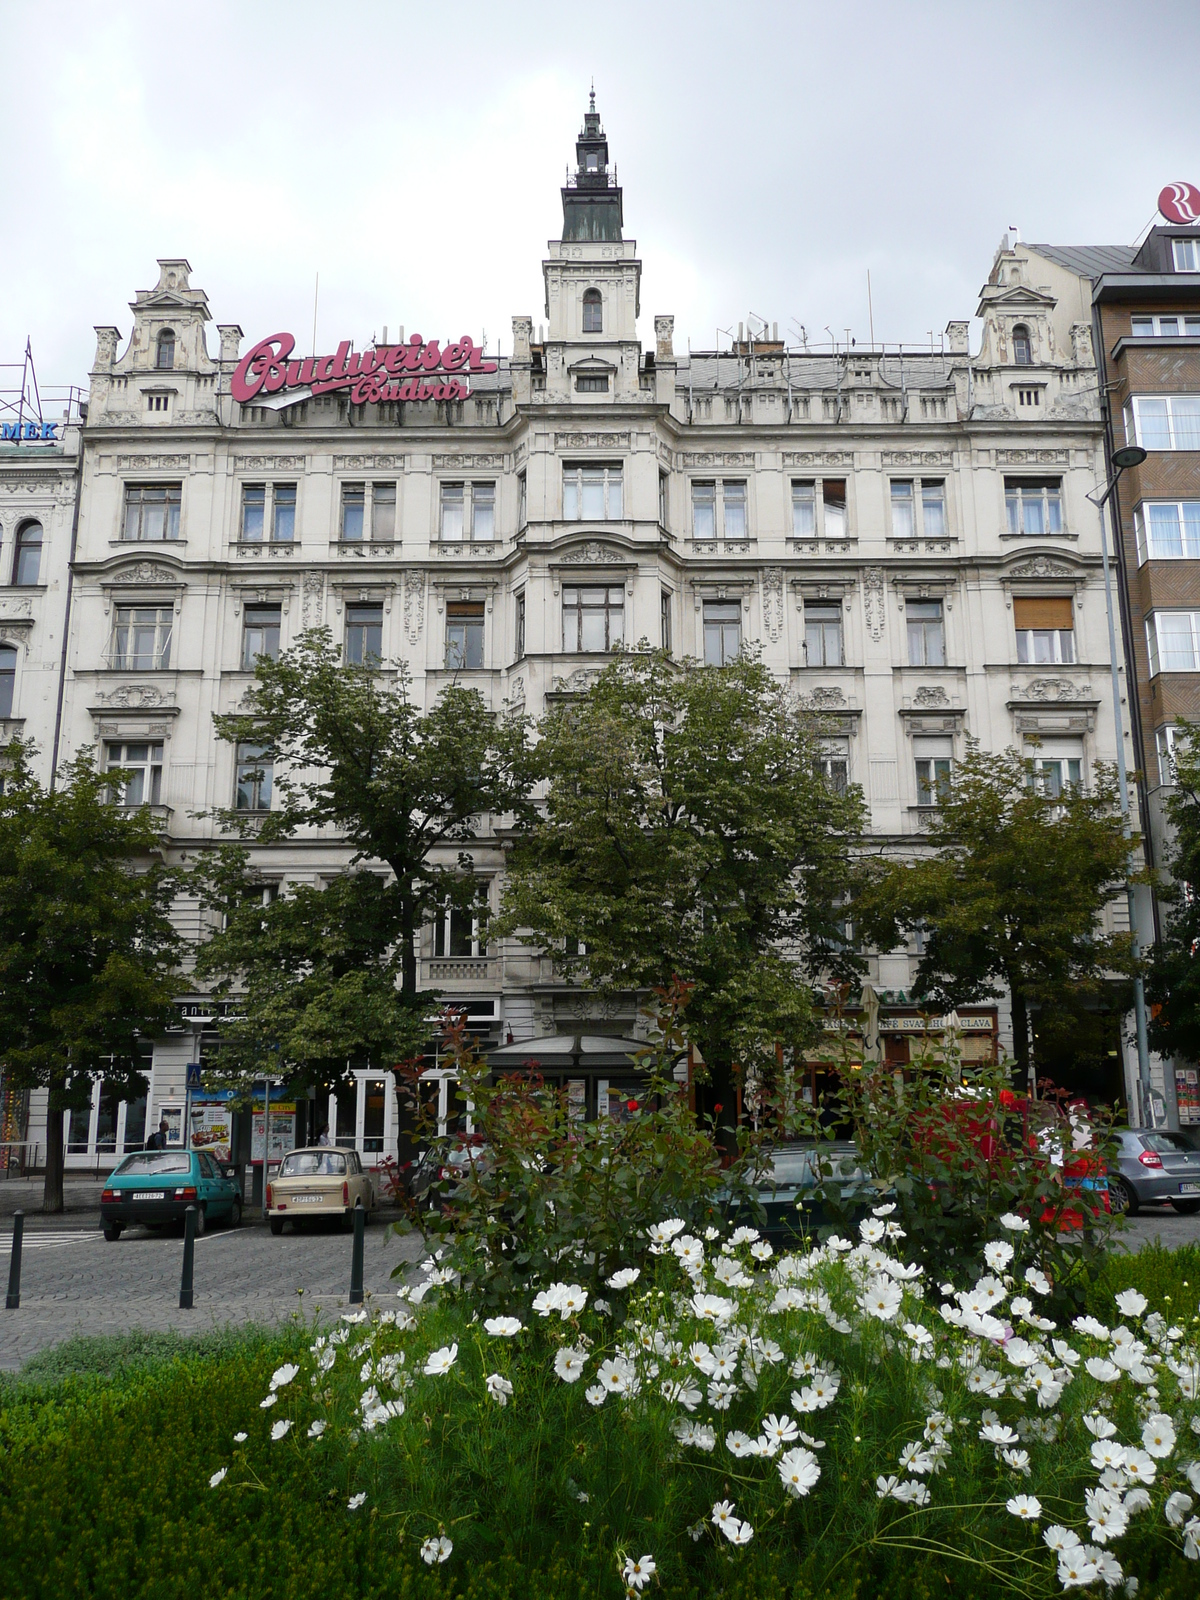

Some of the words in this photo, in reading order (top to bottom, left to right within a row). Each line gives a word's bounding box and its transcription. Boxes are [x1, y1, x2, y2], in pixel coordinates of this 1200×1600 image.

[230, 331, 498, 404] Budweiser
[351, 370, 474, 405] Budvar
[1, 422, 58, 440] MEK
[960, 1019, 991, 1028] CLAVA
